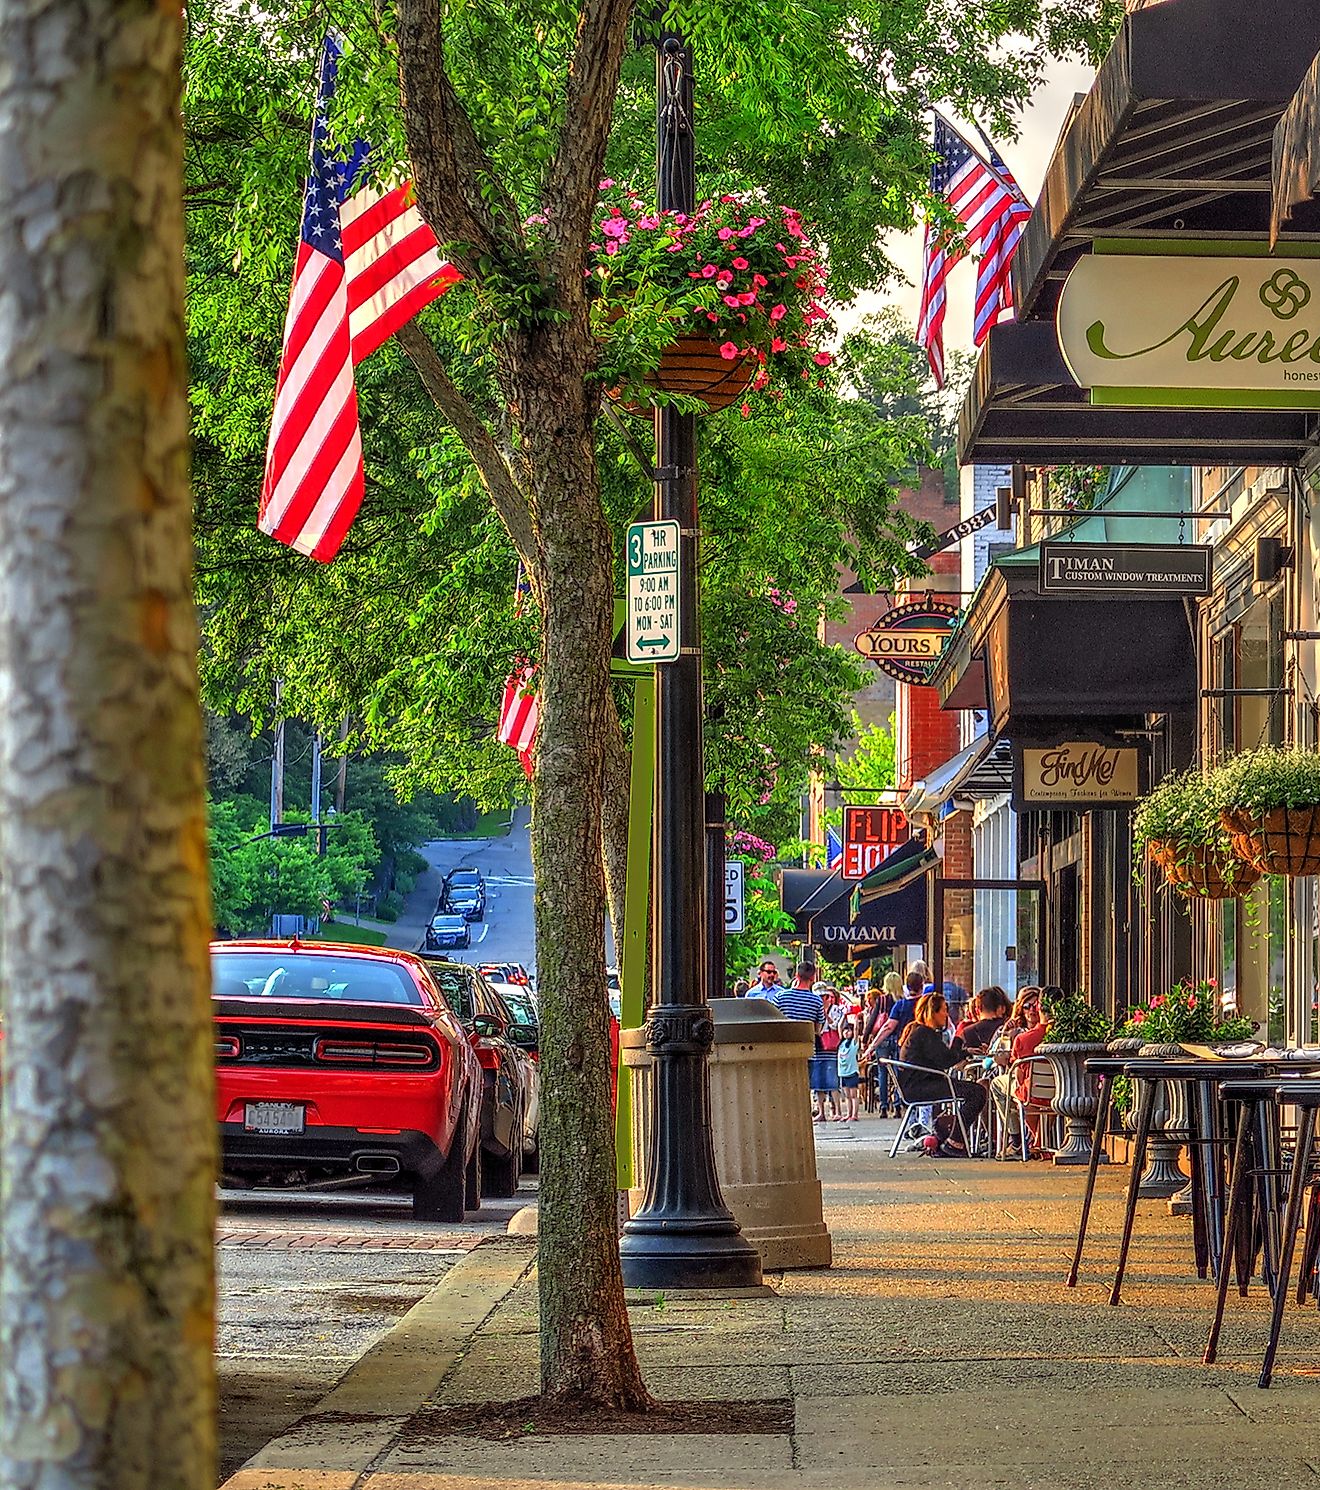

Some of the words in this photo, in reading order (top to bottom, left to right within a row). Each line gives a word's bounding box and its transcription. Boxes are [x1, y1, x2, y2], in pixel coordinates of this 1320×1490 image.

[946, 508, 996, 542] 1981
[630, 534, 642, 568] 3
[653, 529, 667, 547] HR
[643, 550, 677, 570] PARKING
[1048, 557, 1114, 580] TIMAN
[639, 578, 656, 593] 9:00
[658, 576, 669, 592] AM
[1065, 571, 1102, 581] CUSTOM
[1102, 572, 1145, 582] WINDOW
[1145, 573, 1204, 583] TREATMENTS
[634, 596, 643, 612] TO
[644, 596, 662, 612] 6:00
[664, 595, 675, 610] PM
[636, 615, 652, 631] MON
[660, 614, 673, 630] SAT
[866, 634, 931, 653] YOURS
[904, 659, 937, 668] RESTAU
[850, 810, 907, 842] FLIP
[823, 926, 897, 940] UMAMI
